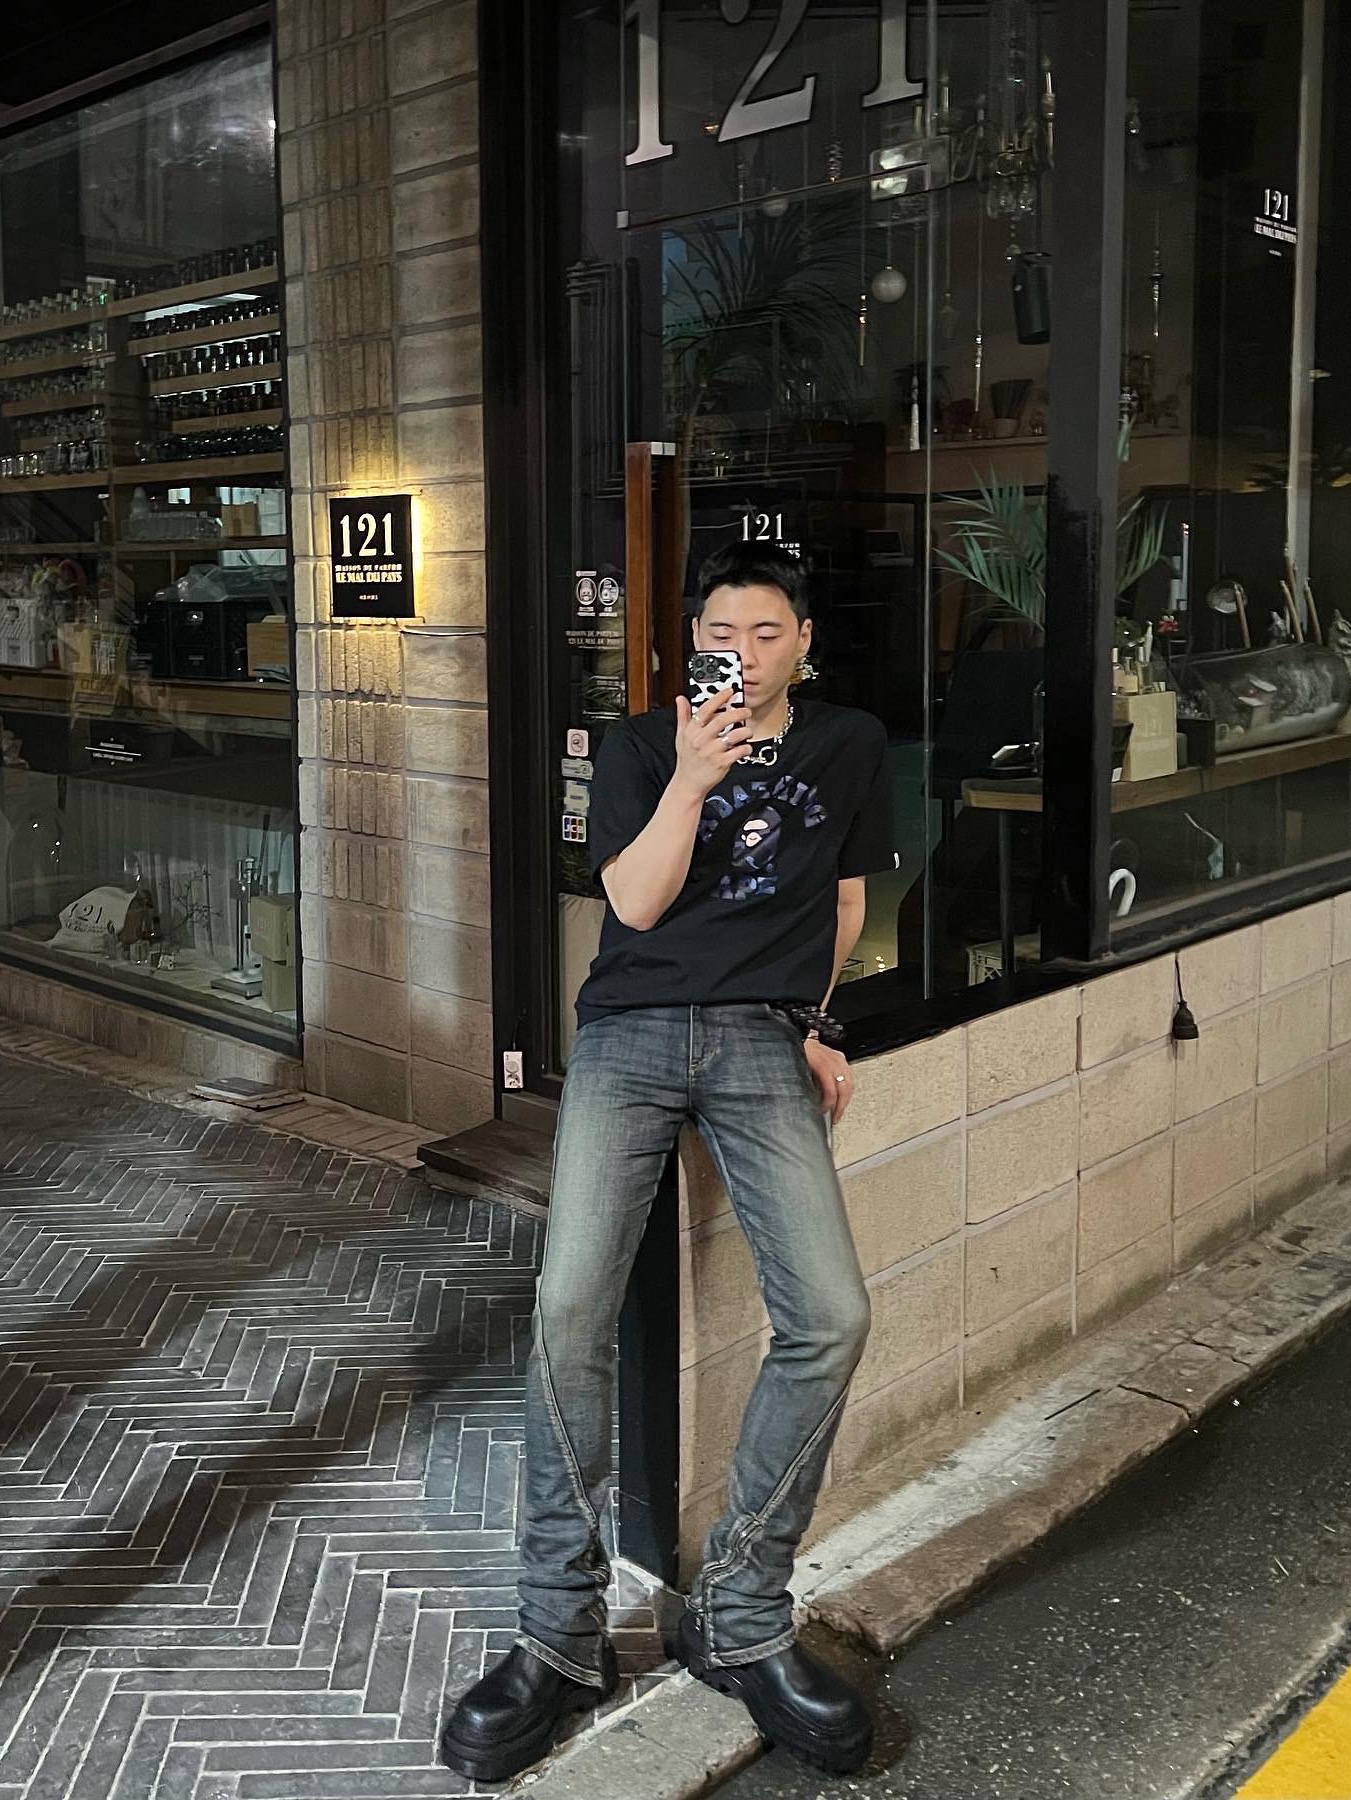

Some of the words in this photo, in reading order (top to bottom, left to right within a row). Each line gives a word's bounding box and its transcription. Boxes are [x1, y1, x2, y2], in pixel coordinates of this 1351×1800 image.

[625, 0, 924, 166] 121
[1264, 188, 1289, 221] 121
[340, 512, 395, 558] 121
[742, 513, 783, 541] 121
[335, 572, 347, 583] LE
[347, 572, 365, 583] MAL
[366, 572, 380, 583] DU
[381, 571, 403, 583] PAYS
[68, 902, 103, 924] 121
